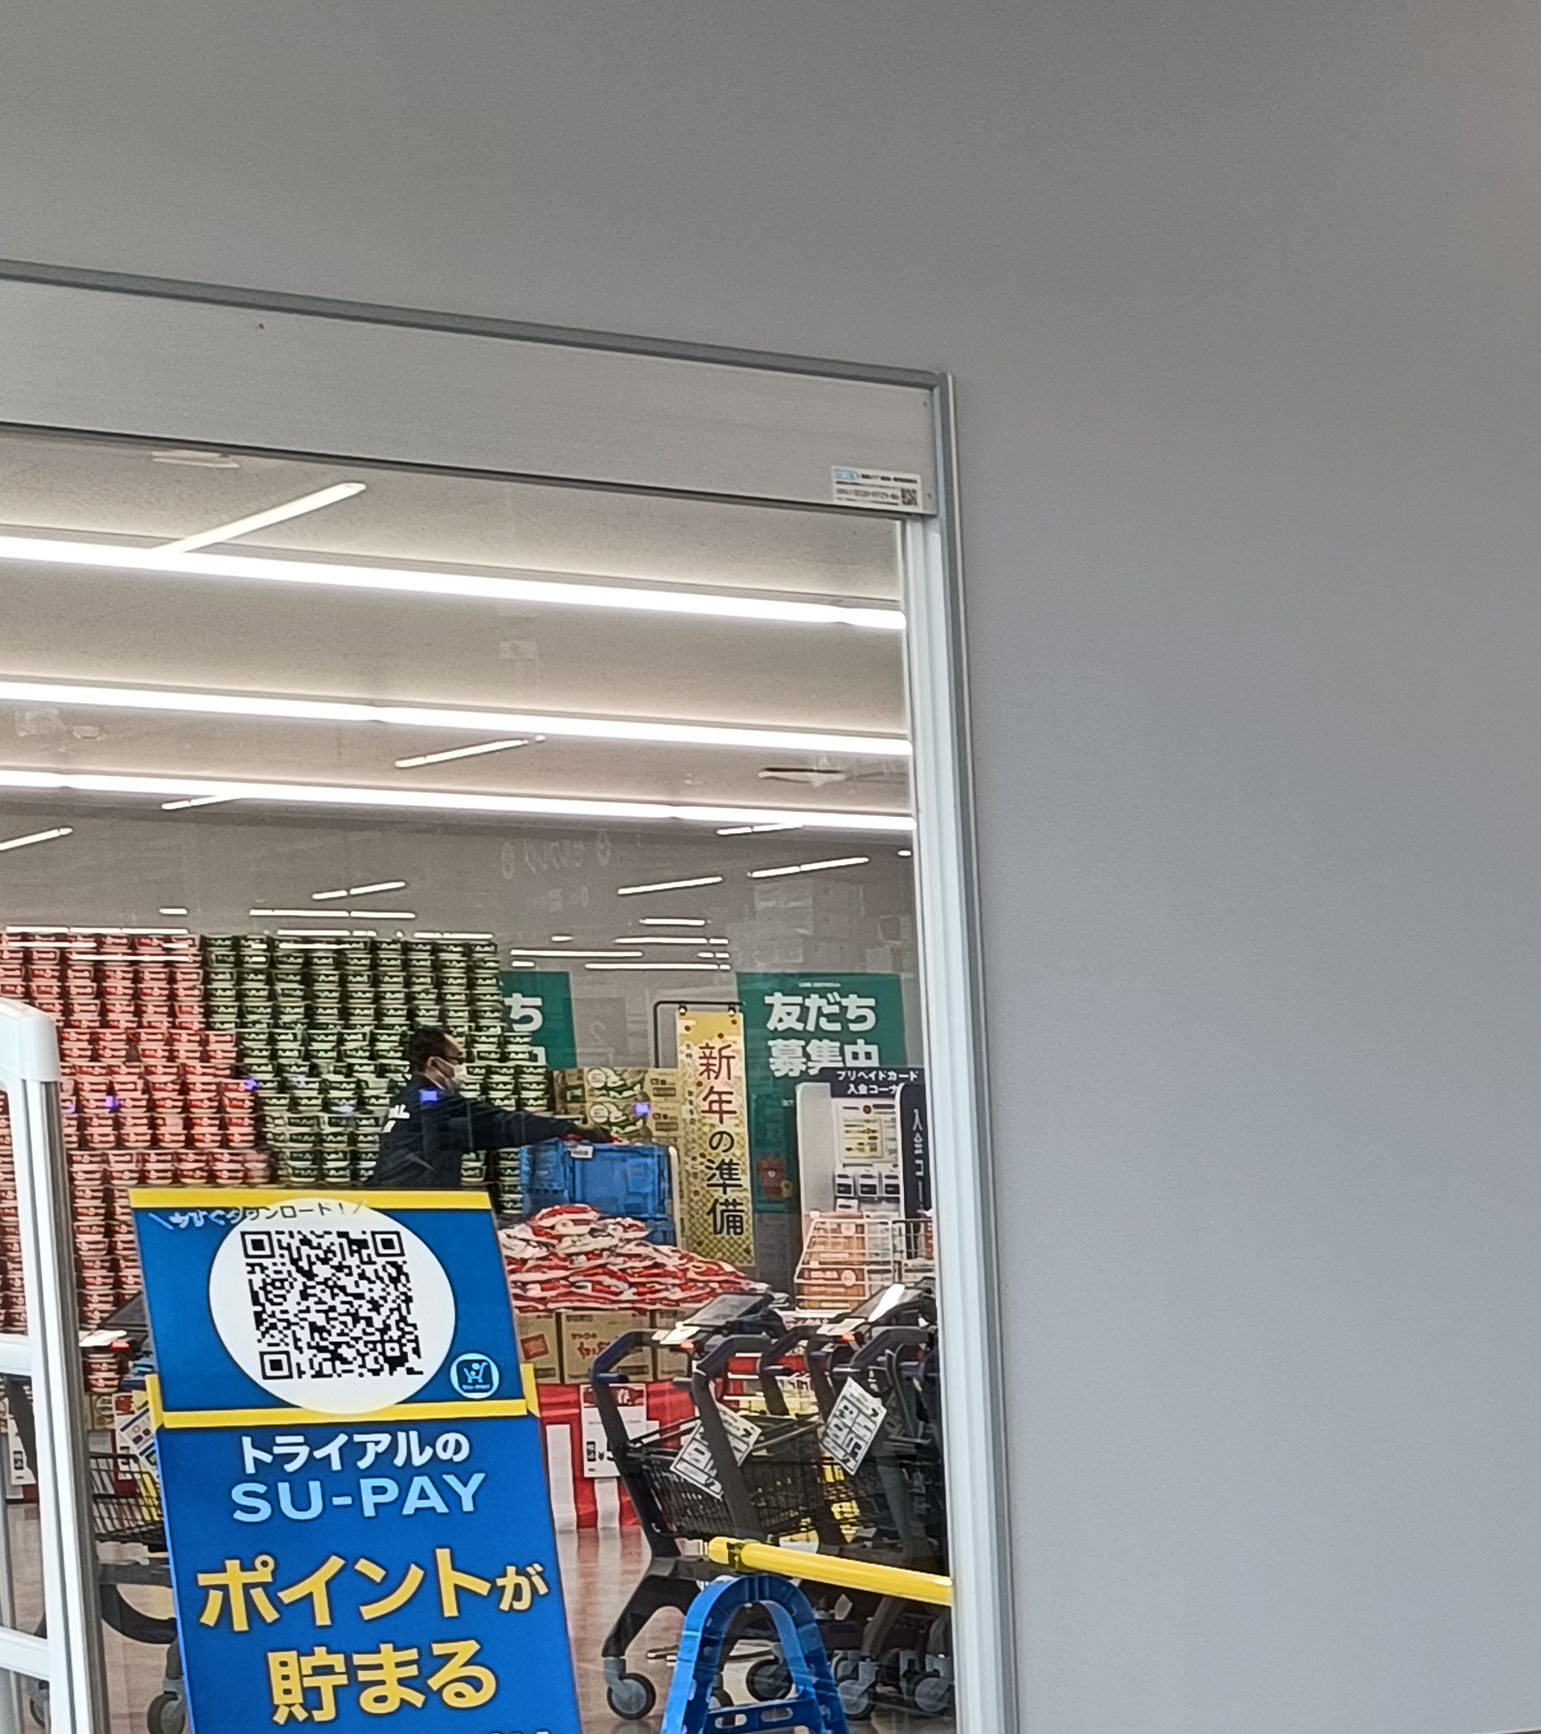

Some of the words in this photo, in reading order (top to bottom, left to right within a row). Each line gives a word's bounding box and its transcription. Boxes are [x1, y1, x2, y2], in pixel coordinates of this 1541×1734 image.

[764, 991, 877, 1032] 友だち
[768, 1038, 880, 1078] 募集中
[836, 1070, 919, 1082] プリペイドカード
[698, 1042, 745, 1237] 新年の準備
[242, 1430, 470, 1474] トライアルの
[231, 1472, 487, 1523] SU-PAY
[197, 1547, 550, 1632] ポイントが
[267, 1640, 497, 1725] 貯まる
